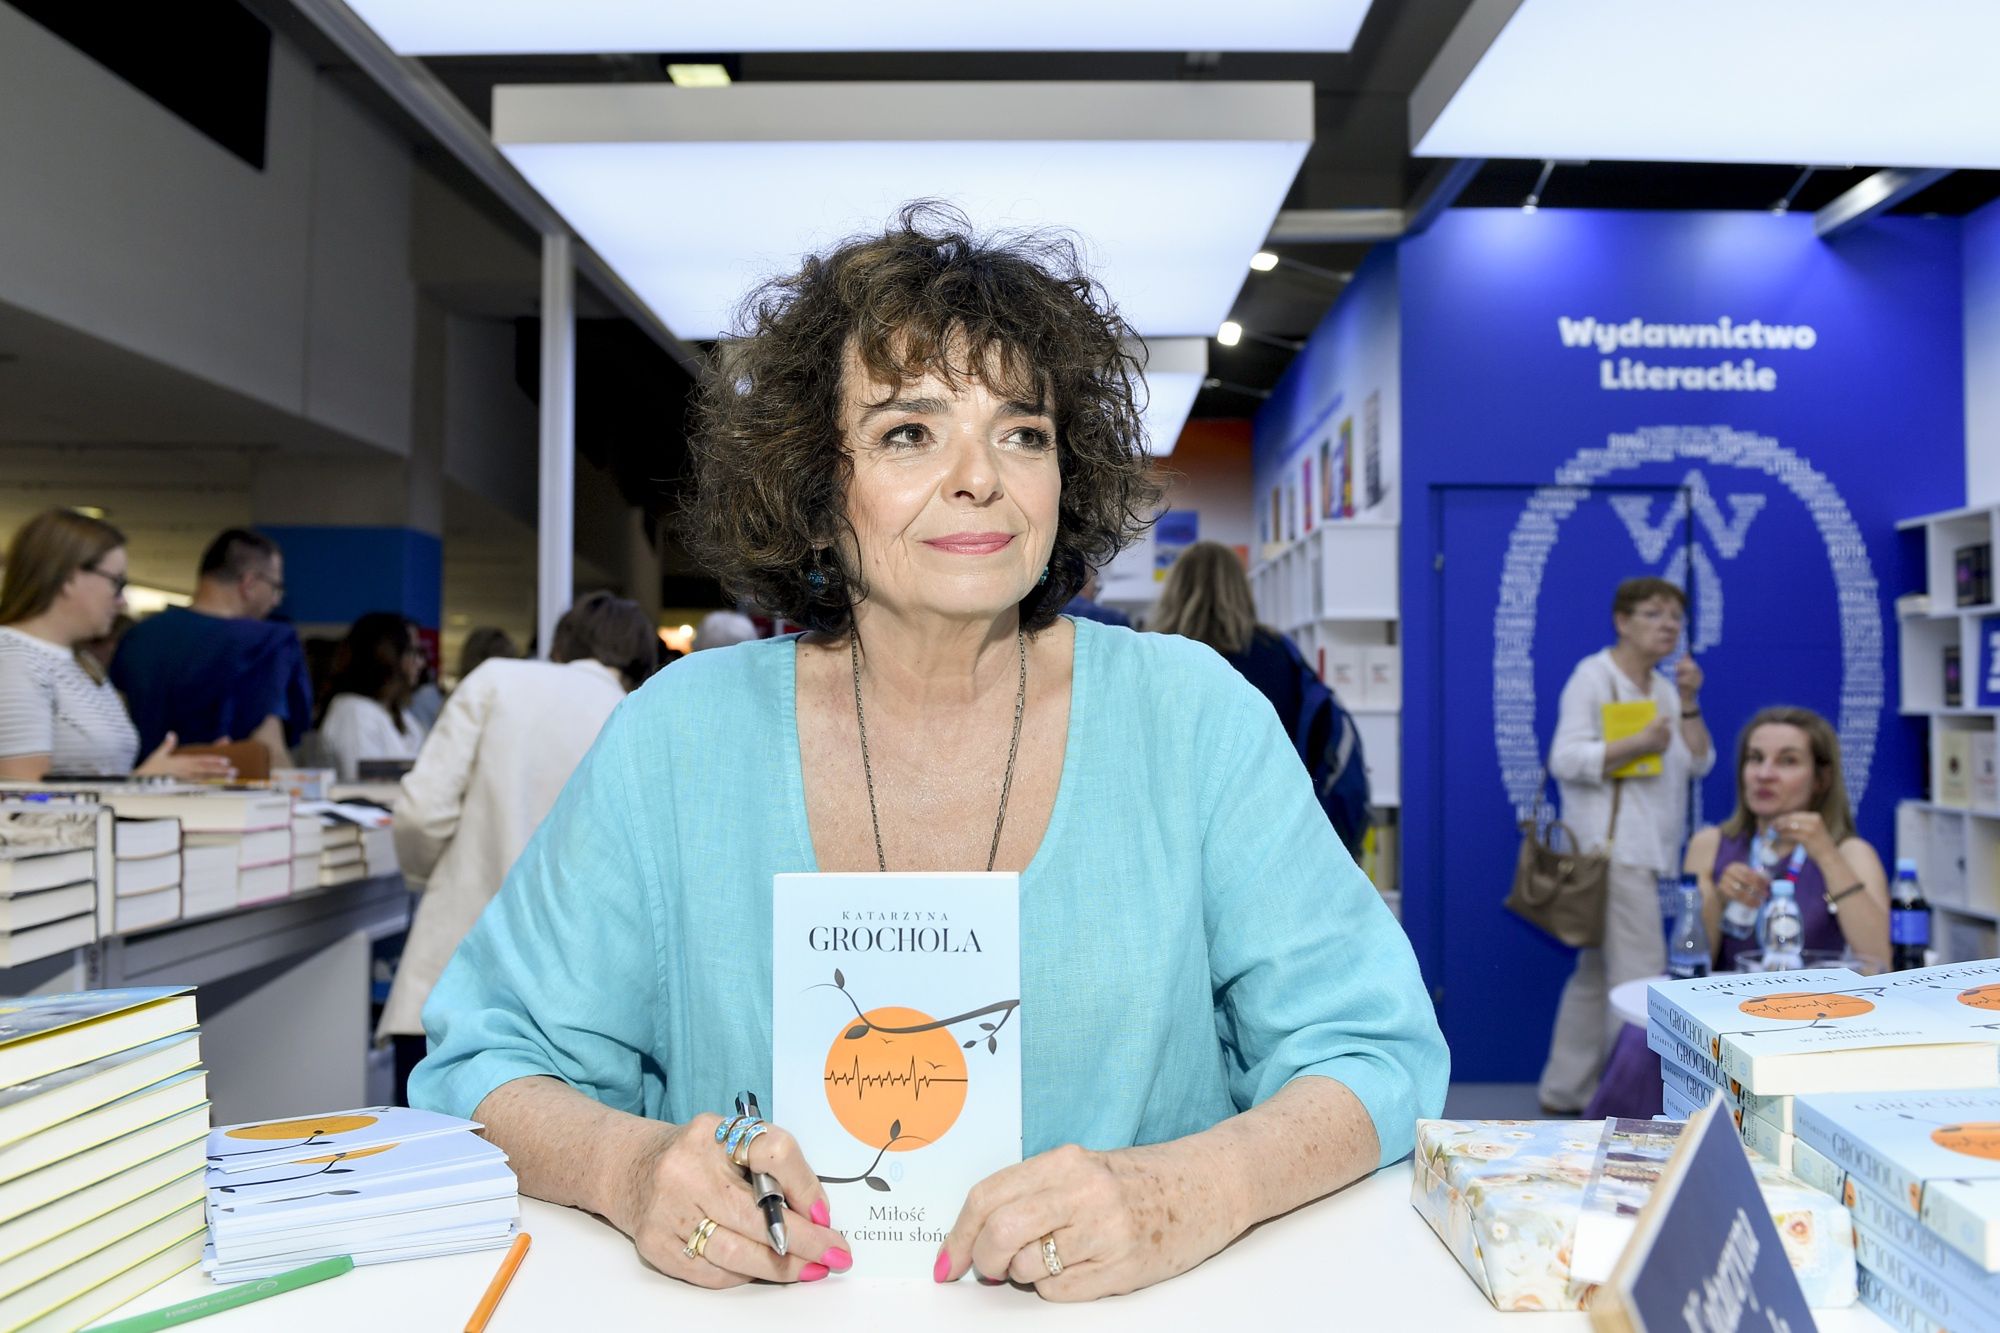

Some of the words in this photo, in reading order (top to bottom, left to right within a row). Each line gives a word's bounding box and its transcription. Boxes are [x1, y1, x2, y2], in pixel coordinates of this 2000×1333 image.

[1558, 316, 1817, 353] Wydawnictwo
[1601, 357, 1777, 391] Literackie
[842, 911, 949, 921] KATARZYNA
[808, 926, 983, 953] GROCHOLA
[1893, 965, 2000, 987] GROCHO
[1669, 1008, 1711, 1054] GROCHOLA
[1676, 1041, 1729, 1090] GROCHOLA
[869, 1206, 927, 1222] Miłość
[854, 1228, 904, 1241] cieniu
